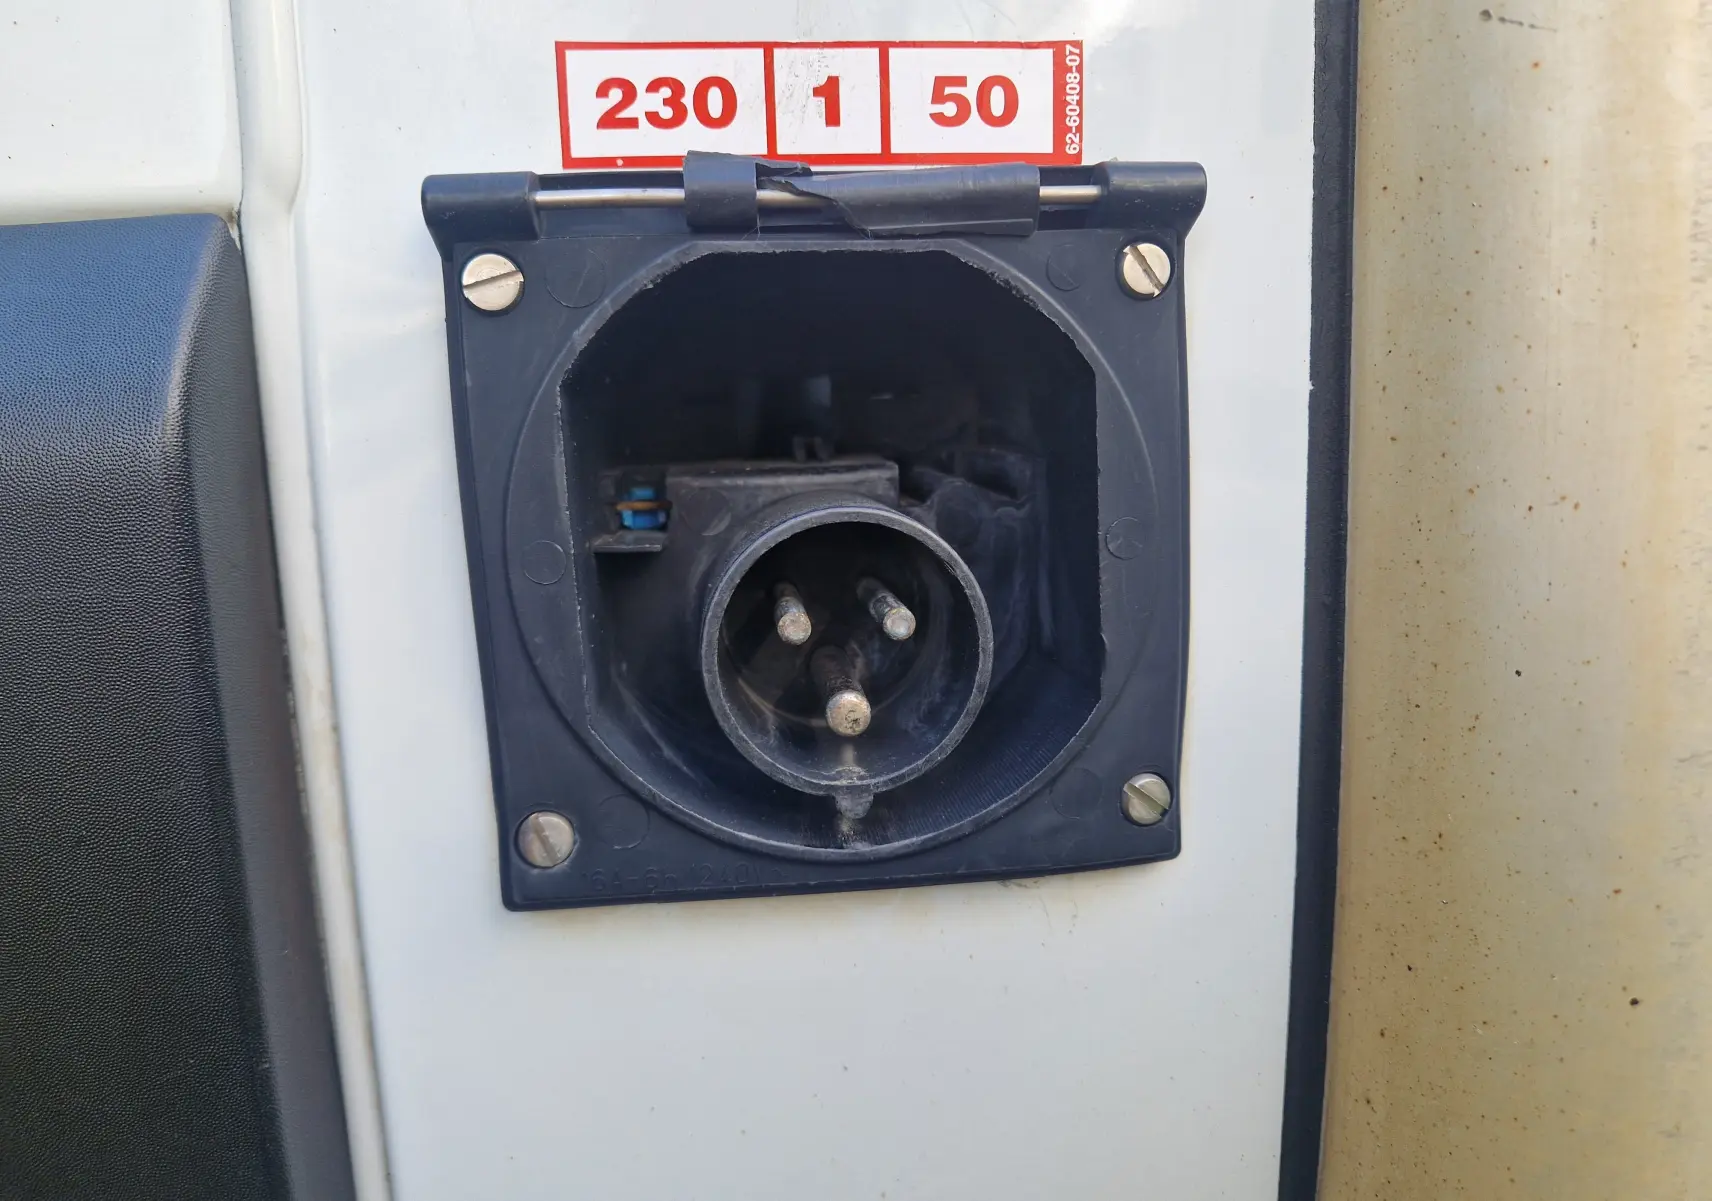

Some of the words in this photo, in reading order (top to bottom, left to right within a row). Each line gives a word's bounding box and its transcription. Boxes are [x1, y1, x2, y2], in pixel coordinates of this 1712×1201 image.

[595, 76, 738, 129] 230
[812, 75, 841, 127] 1
[929, 75, 1019, 127] 50
[1065, 43, 1081, 156] 62-60408-07
